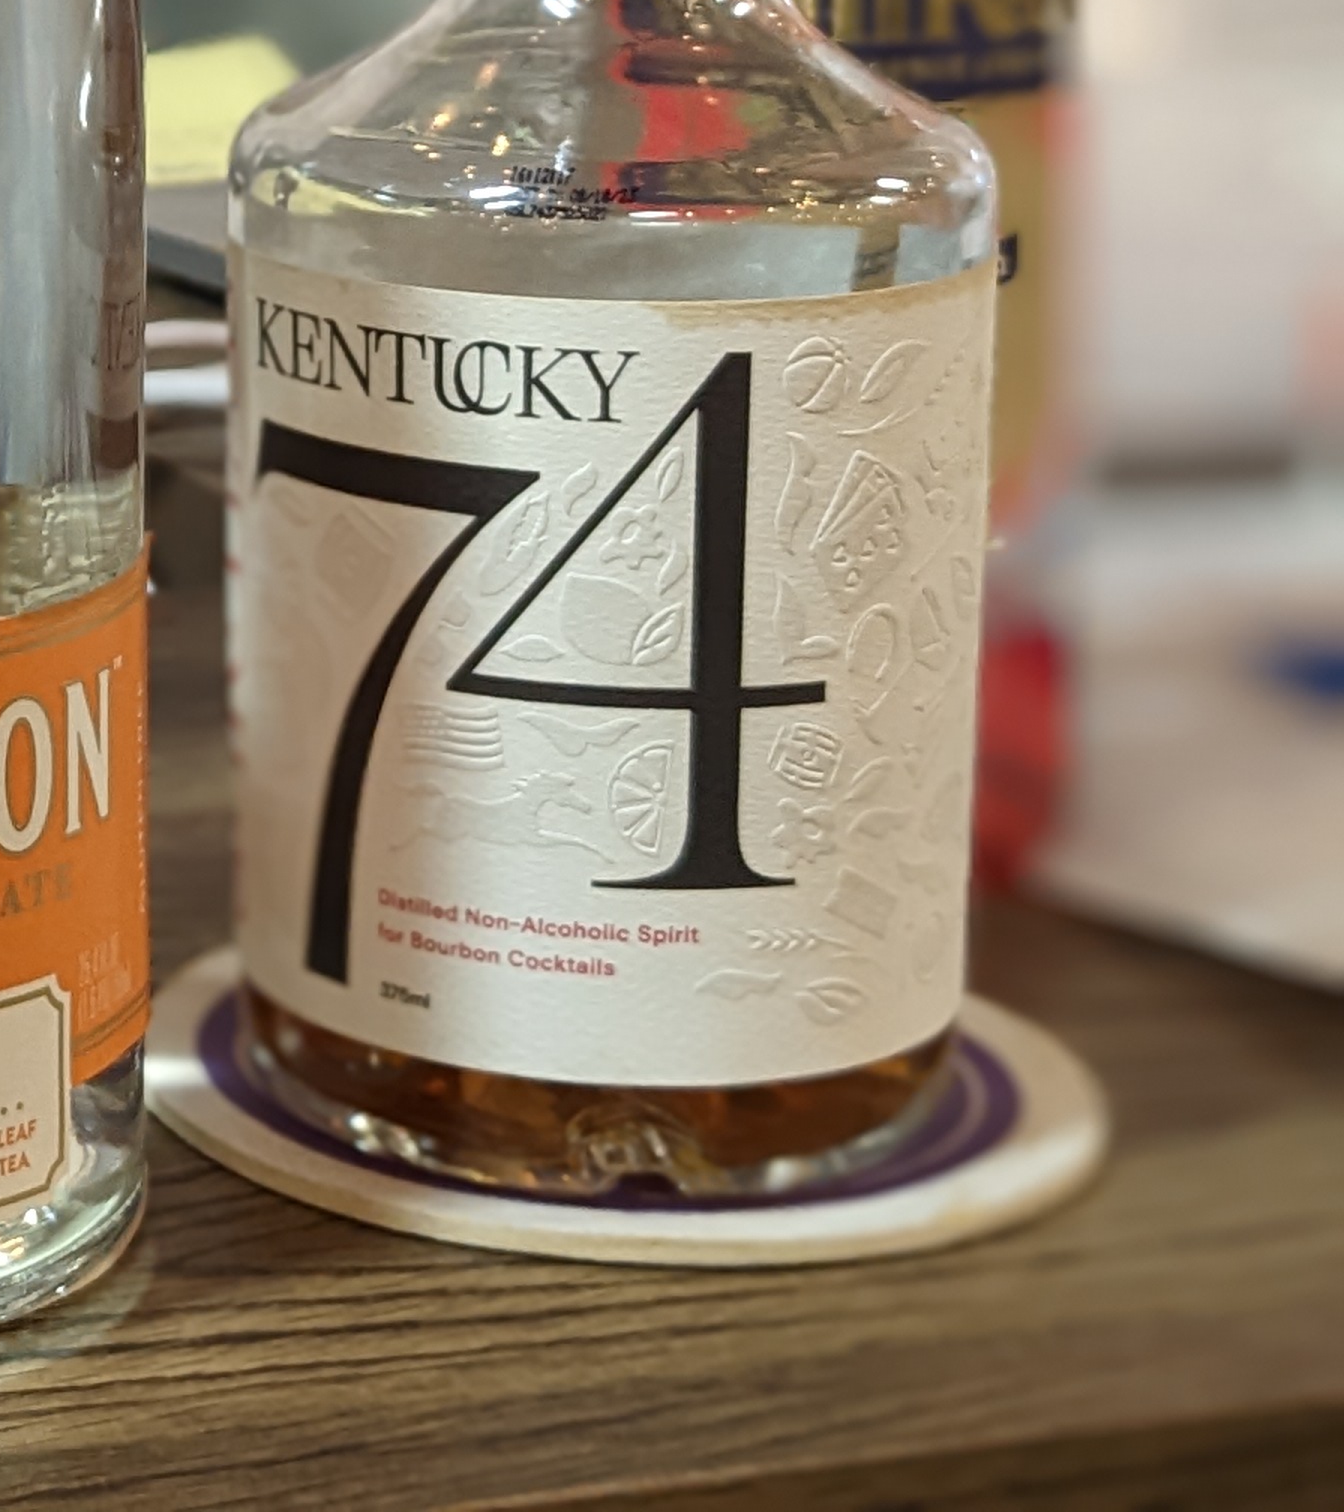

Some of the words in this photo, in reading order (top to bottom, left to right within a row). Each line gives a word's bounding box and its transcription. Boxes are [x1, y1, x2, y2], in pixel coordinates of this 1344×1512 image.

[256, 296, 640, 425] KENTUCKY
[255, 350, 827, 986] 74
[376, 888, 458, 923] Distilled
[464, 907, 629, 944] Non-Alcoholic
[637, 923, 701, 947] Spirit
[377, 921, 408, 944] for
[409, 930, 501, 965] Bourbon
[506, 948, 617, 977] Cocktails
